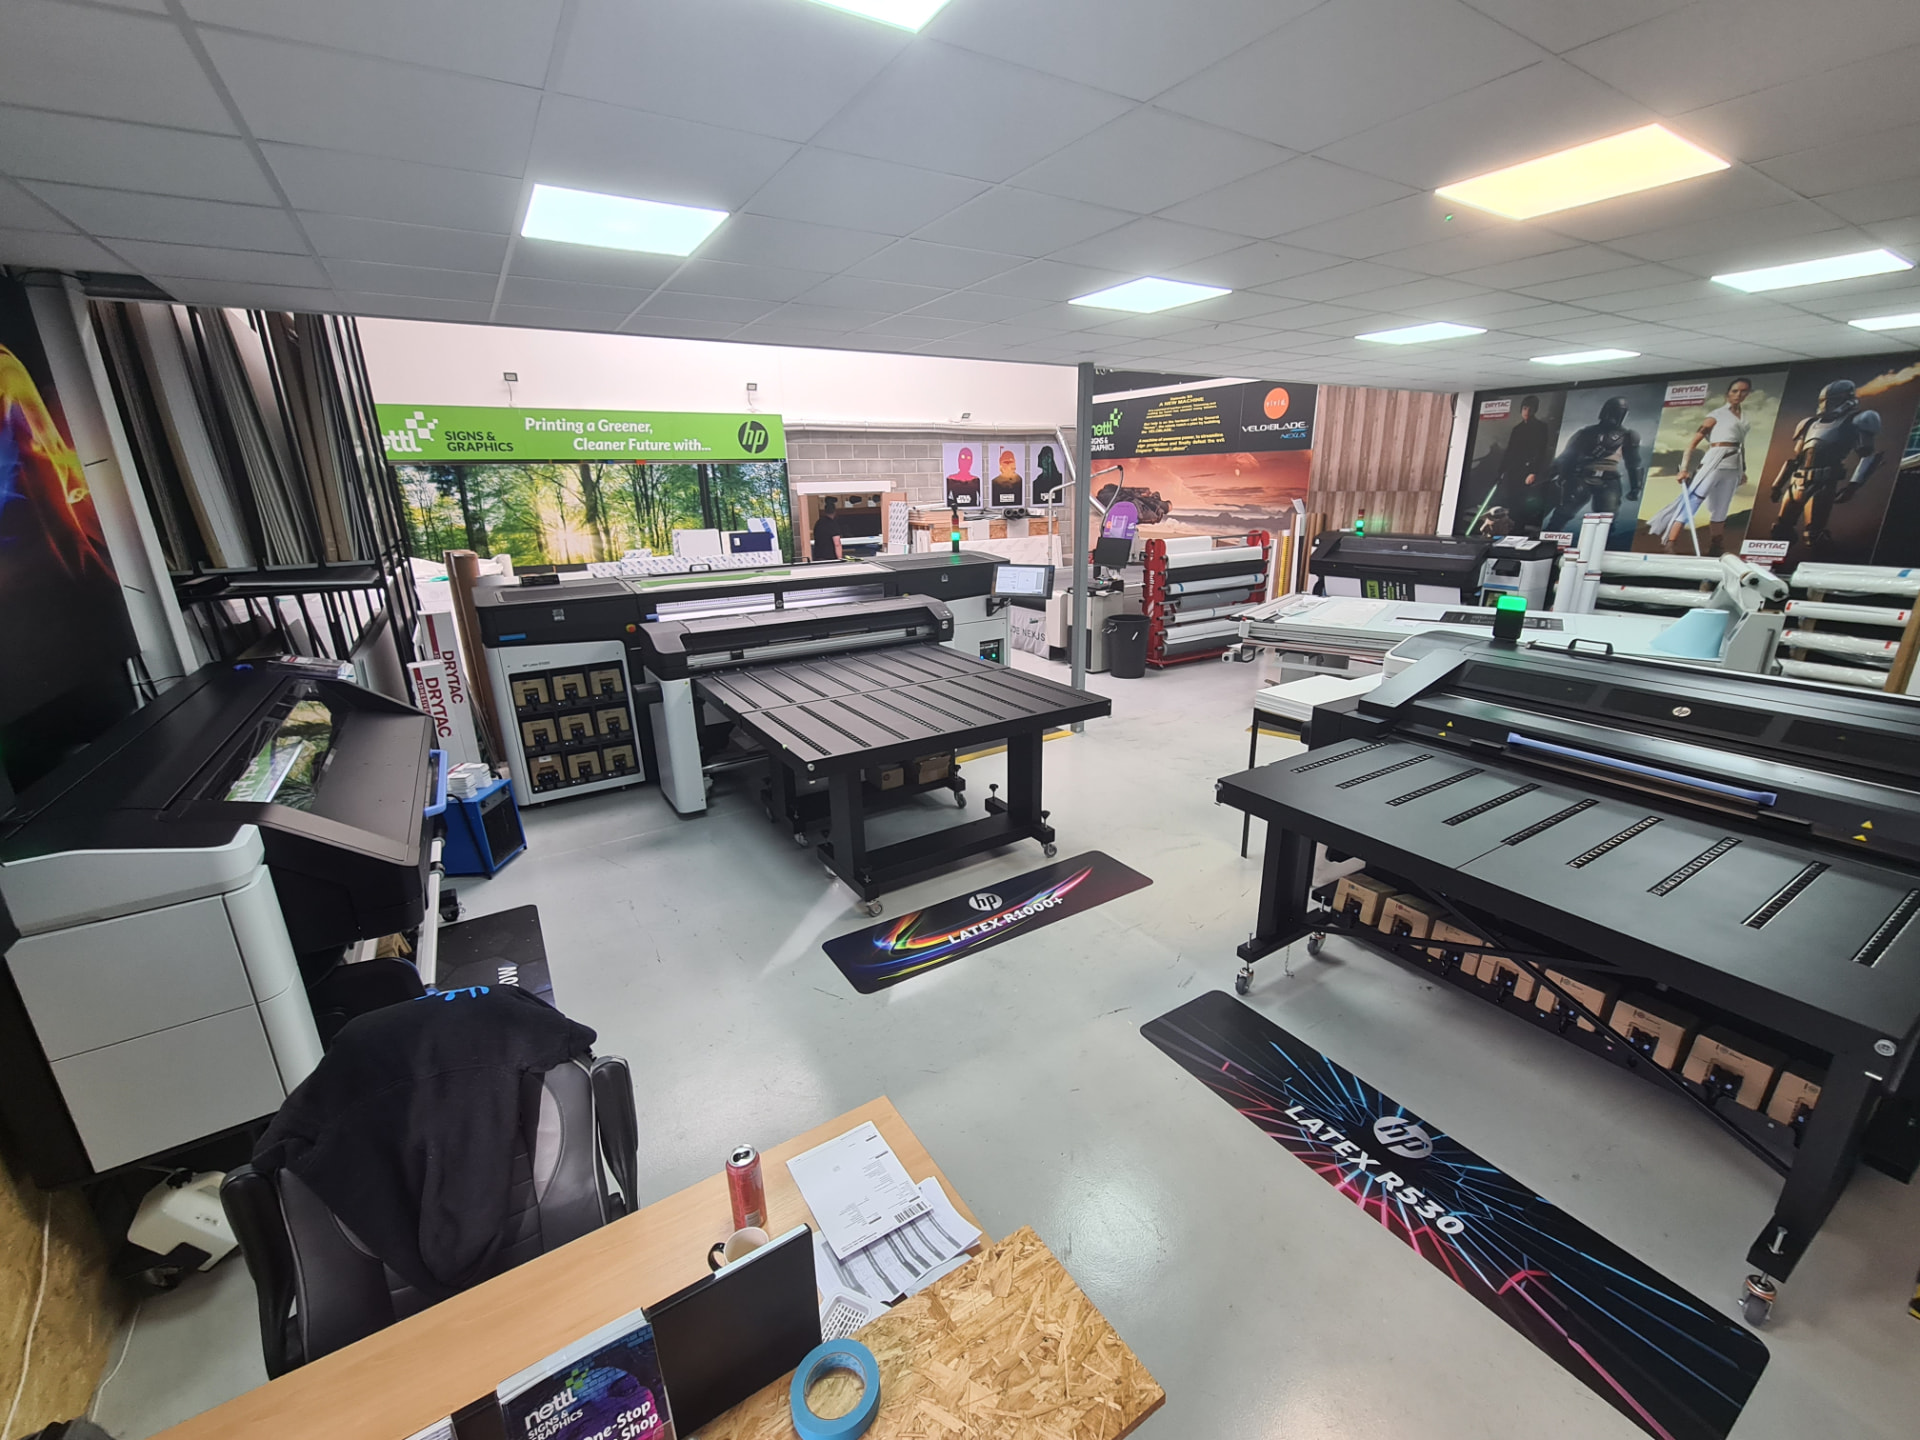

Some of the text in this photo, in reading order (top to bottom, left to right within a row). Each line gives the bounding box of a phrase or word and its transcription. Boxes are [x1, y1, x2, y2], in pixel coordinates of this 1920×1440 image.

[1671, 385, 1706, 394] DRYTAC
[1485, 401, 1510, 409] DRYTAC
[444, 431, 496, 442] SIGNS &
[524, 417, 653, 435] Printing a Greener,
[738, 421, 769, 454] hp
[447, 442, 514, 453] GRAPHICS
[573, 438, 711, 452] Cleaner Future with...
[1748, 542, 1787, 550] DRYTAC
[442, 650, 464, 704] DRYTAC
[425, 677, 452, 738] DRYTAC
[968, 892, 1003, 911] hp
[947, 897, 1064, 945] LATEX R1000+
[1373, 1116, 1433, 1159] hp
[1284, 1105, 1465, 1235] LATEX R530
[524, 1388, 578, 1430] nettl
[528, 1409, 569, 1438] SIGNS &
[621, 1413, 659, 1440] Shop
